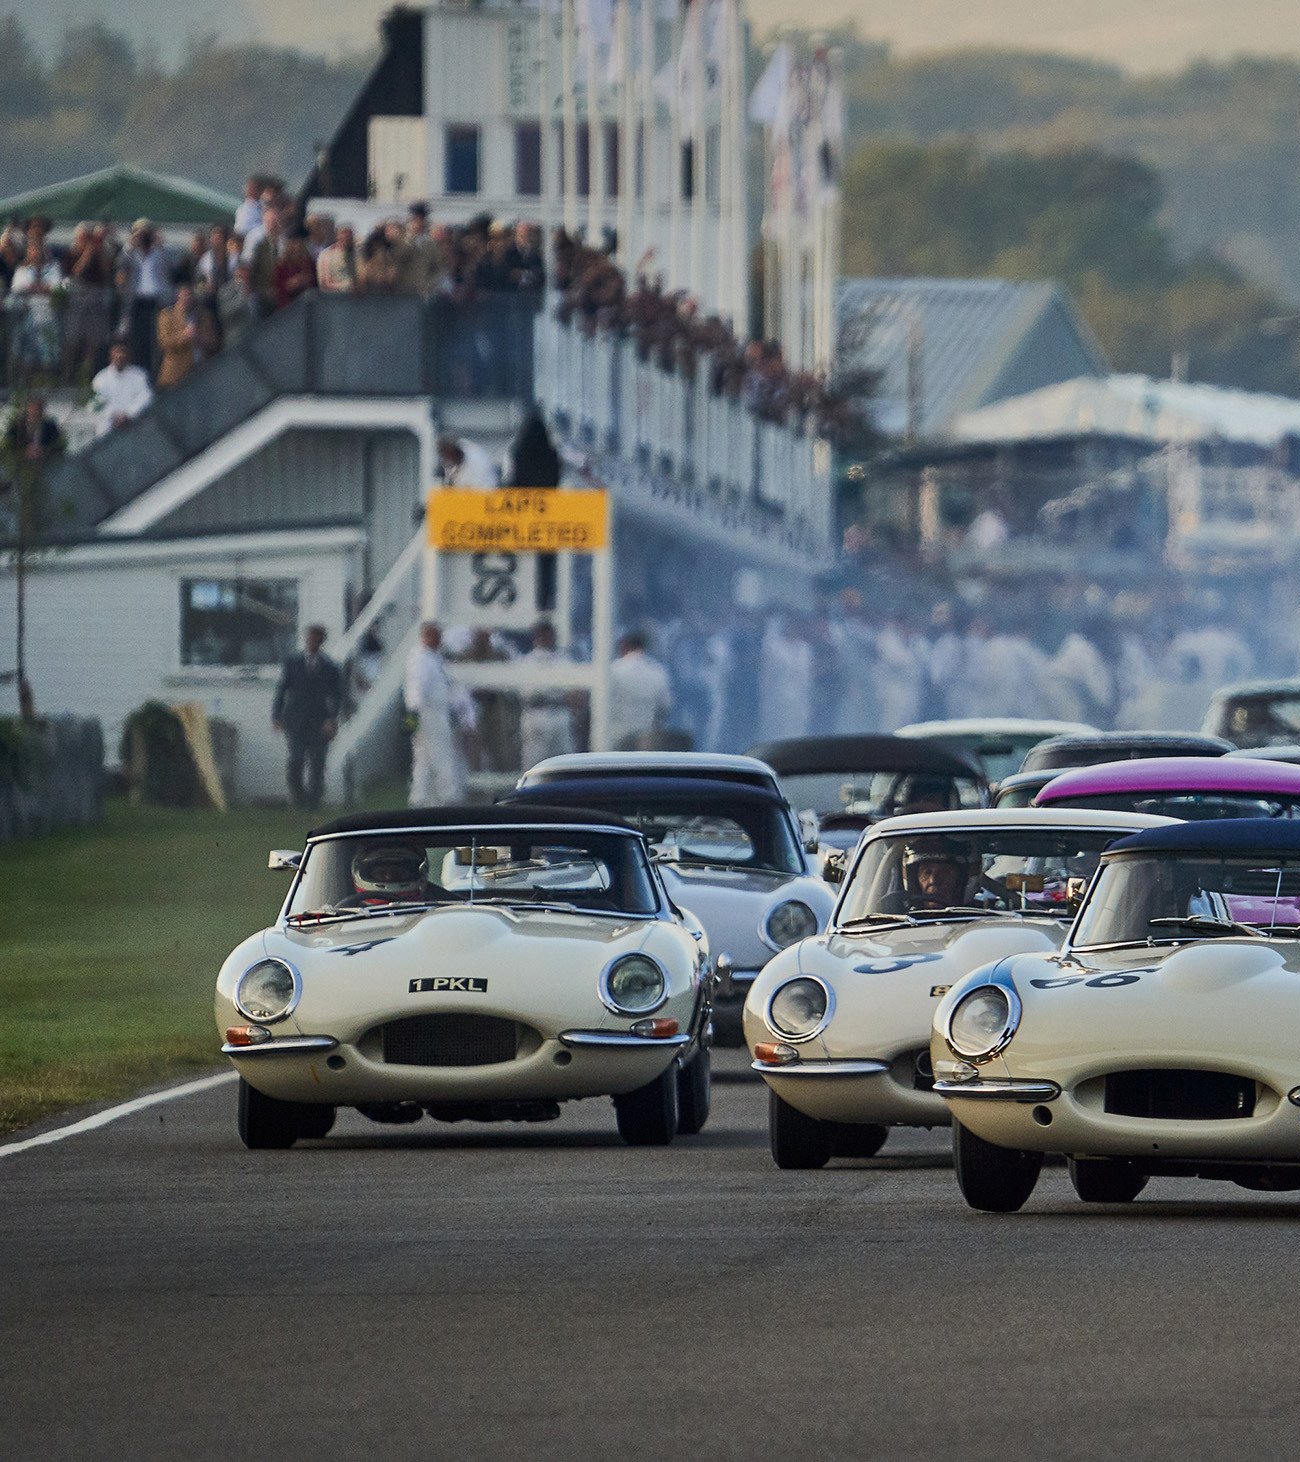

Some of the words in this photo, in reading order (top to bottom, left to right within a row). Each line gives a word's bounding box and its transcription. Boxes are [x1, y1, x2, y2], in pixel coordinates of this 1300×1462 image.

[485, 490, 547, 513] LAPS
[441, 520, 589, 542] COMPLETED
[412, 979, 422, 991] 1
[433, 978, 482, 991] PKL
